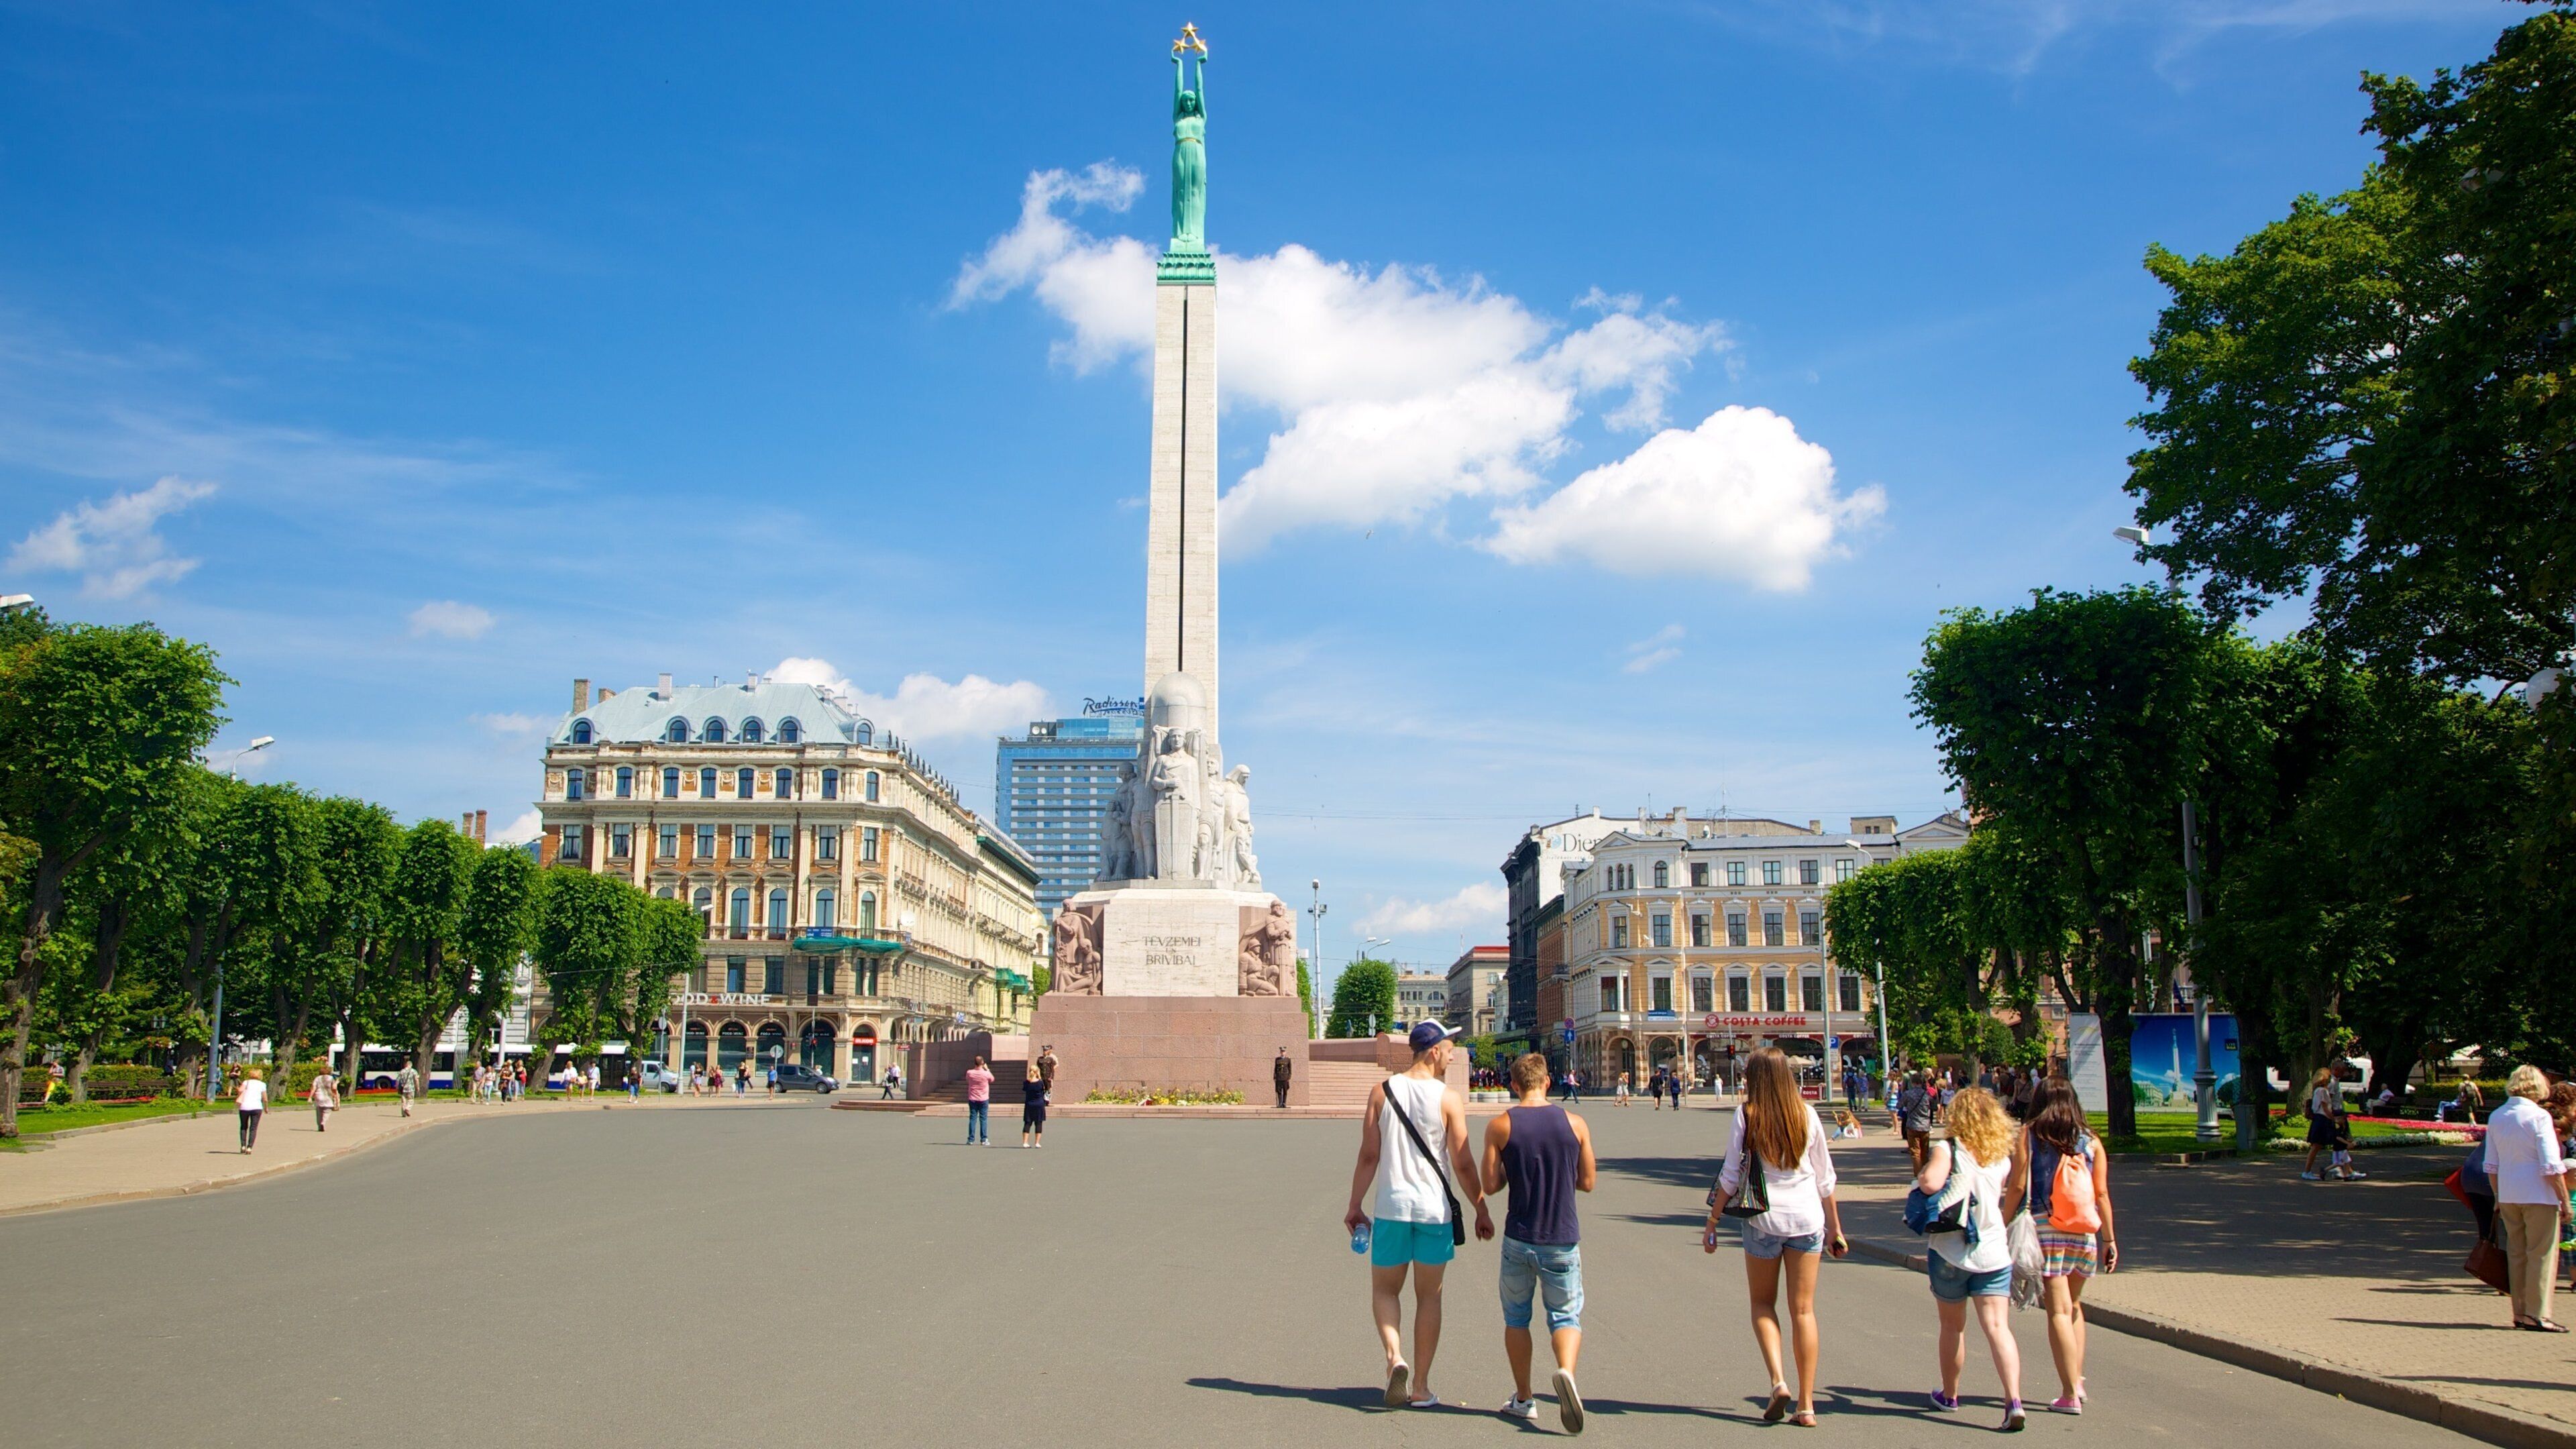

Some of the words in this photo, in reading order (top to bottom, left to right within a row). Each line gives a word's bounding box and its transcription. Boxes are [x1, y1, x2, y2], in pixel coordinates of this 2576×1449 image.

[1083, 695, 1138, 715] Radisson
[1723, 1017, 1760, 1027] COSTA
[1764, 1016, 1807, 1026] COFFEE
